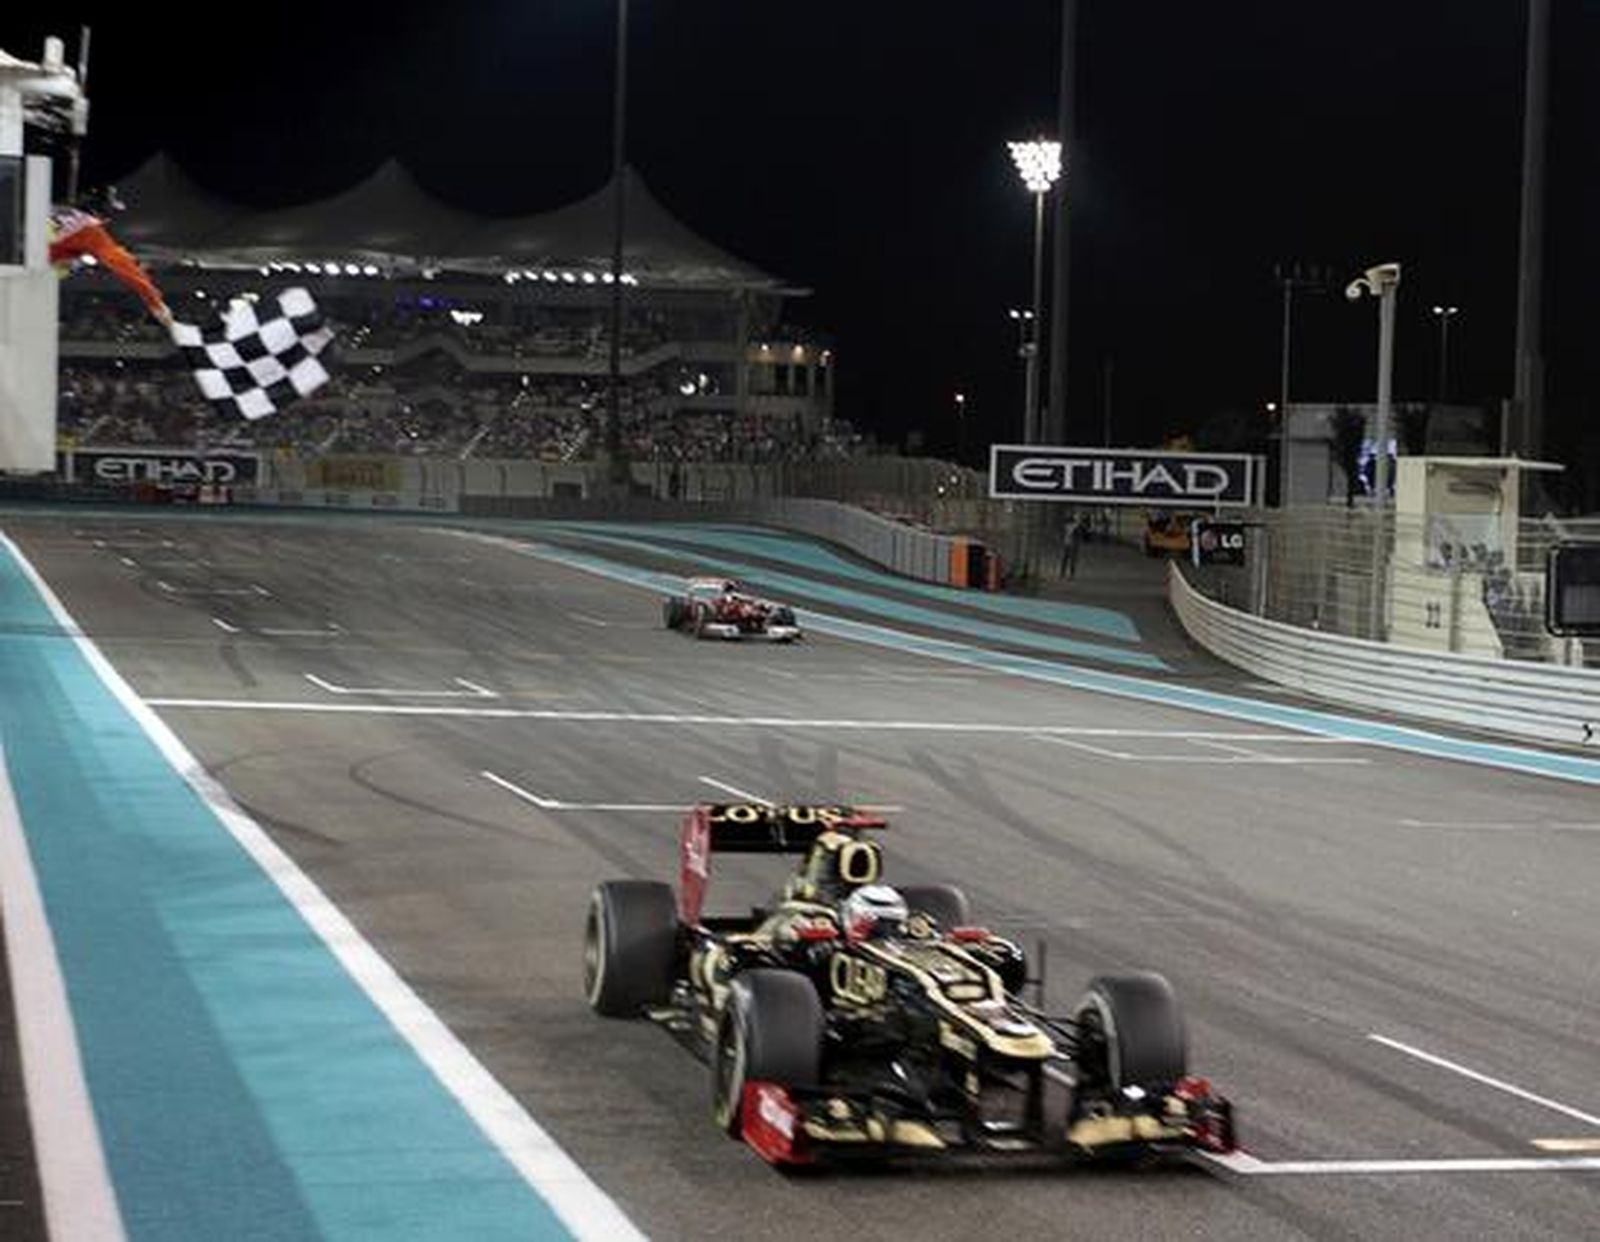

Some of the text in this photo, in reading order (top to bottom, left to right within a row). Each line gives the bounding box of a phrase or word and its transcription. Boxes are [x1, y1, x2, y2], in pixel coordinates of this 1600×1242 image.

[95, 457, 236, 482] ETIHAD
[1012, 458, 1230, 494] ETIHAD
[1221, 533, 1243, 548] LG
